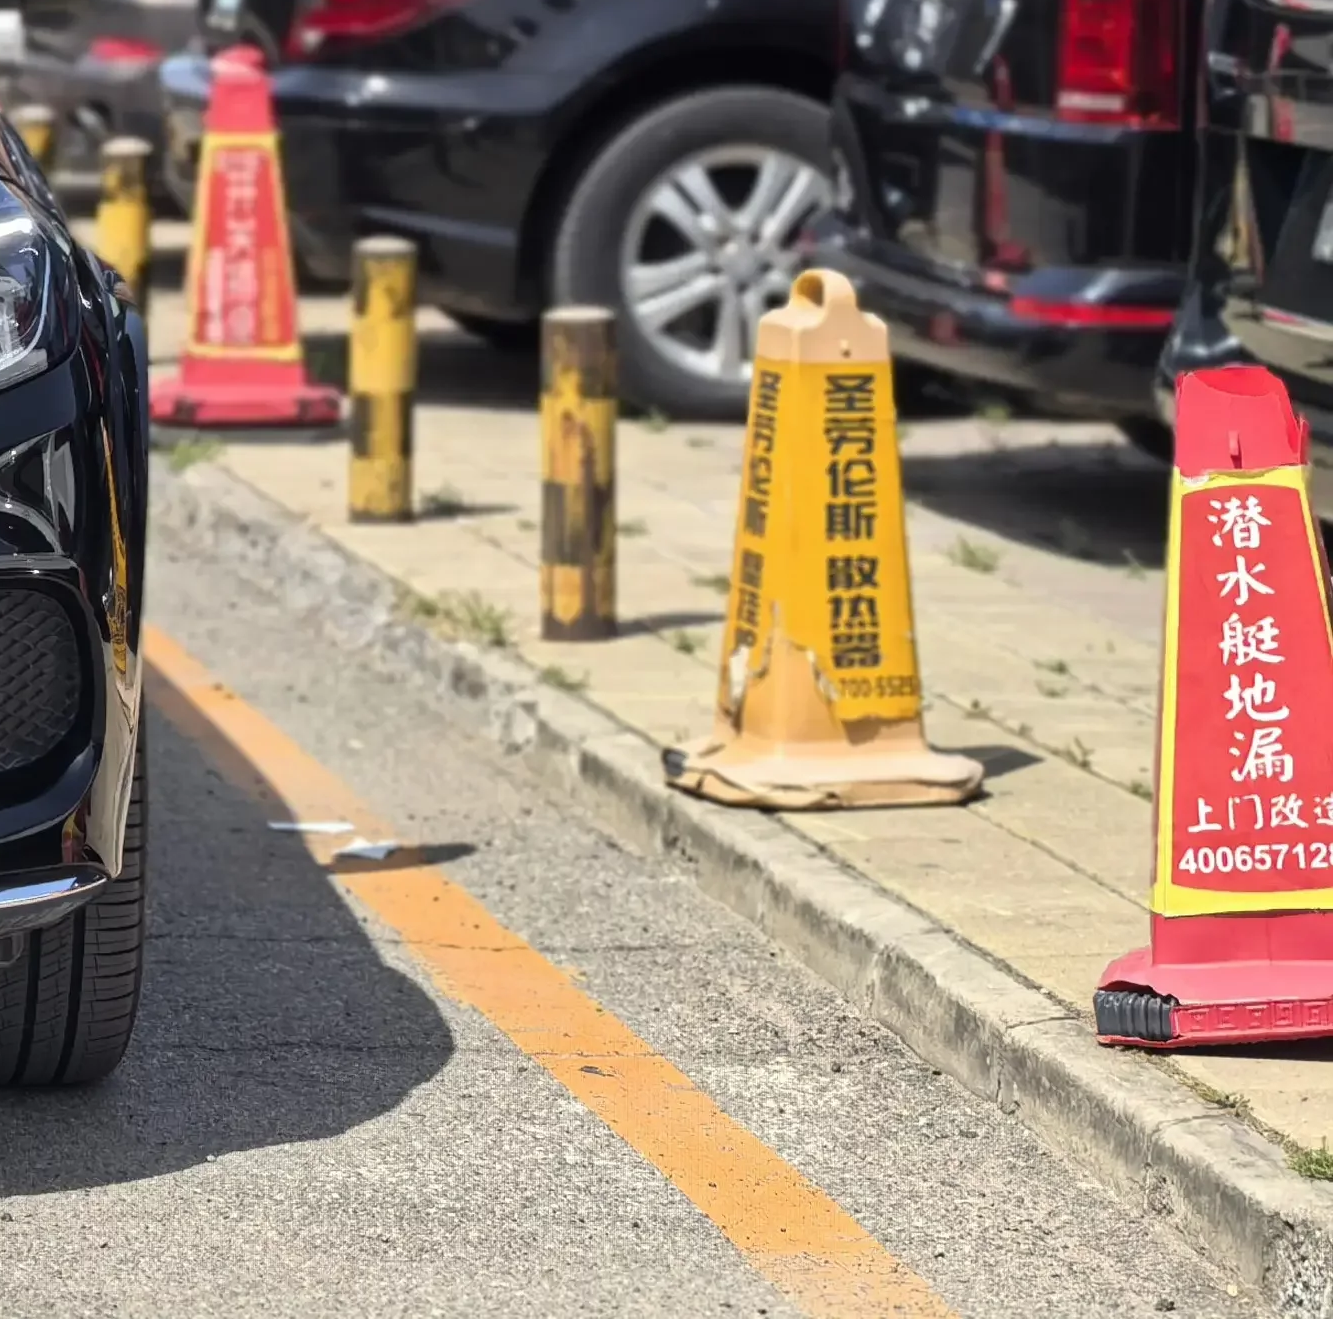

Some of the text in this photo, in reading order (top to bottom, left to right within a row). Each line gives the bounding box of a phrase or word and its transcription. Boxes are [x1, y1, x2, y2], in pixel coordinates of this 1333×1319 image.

[823, 373, 883, 669] 圣劳伦斯 散热器
[1207, 493, 1294, 783] 潜水艇地漏
[1179, 842, 1333, 875] 40065712
